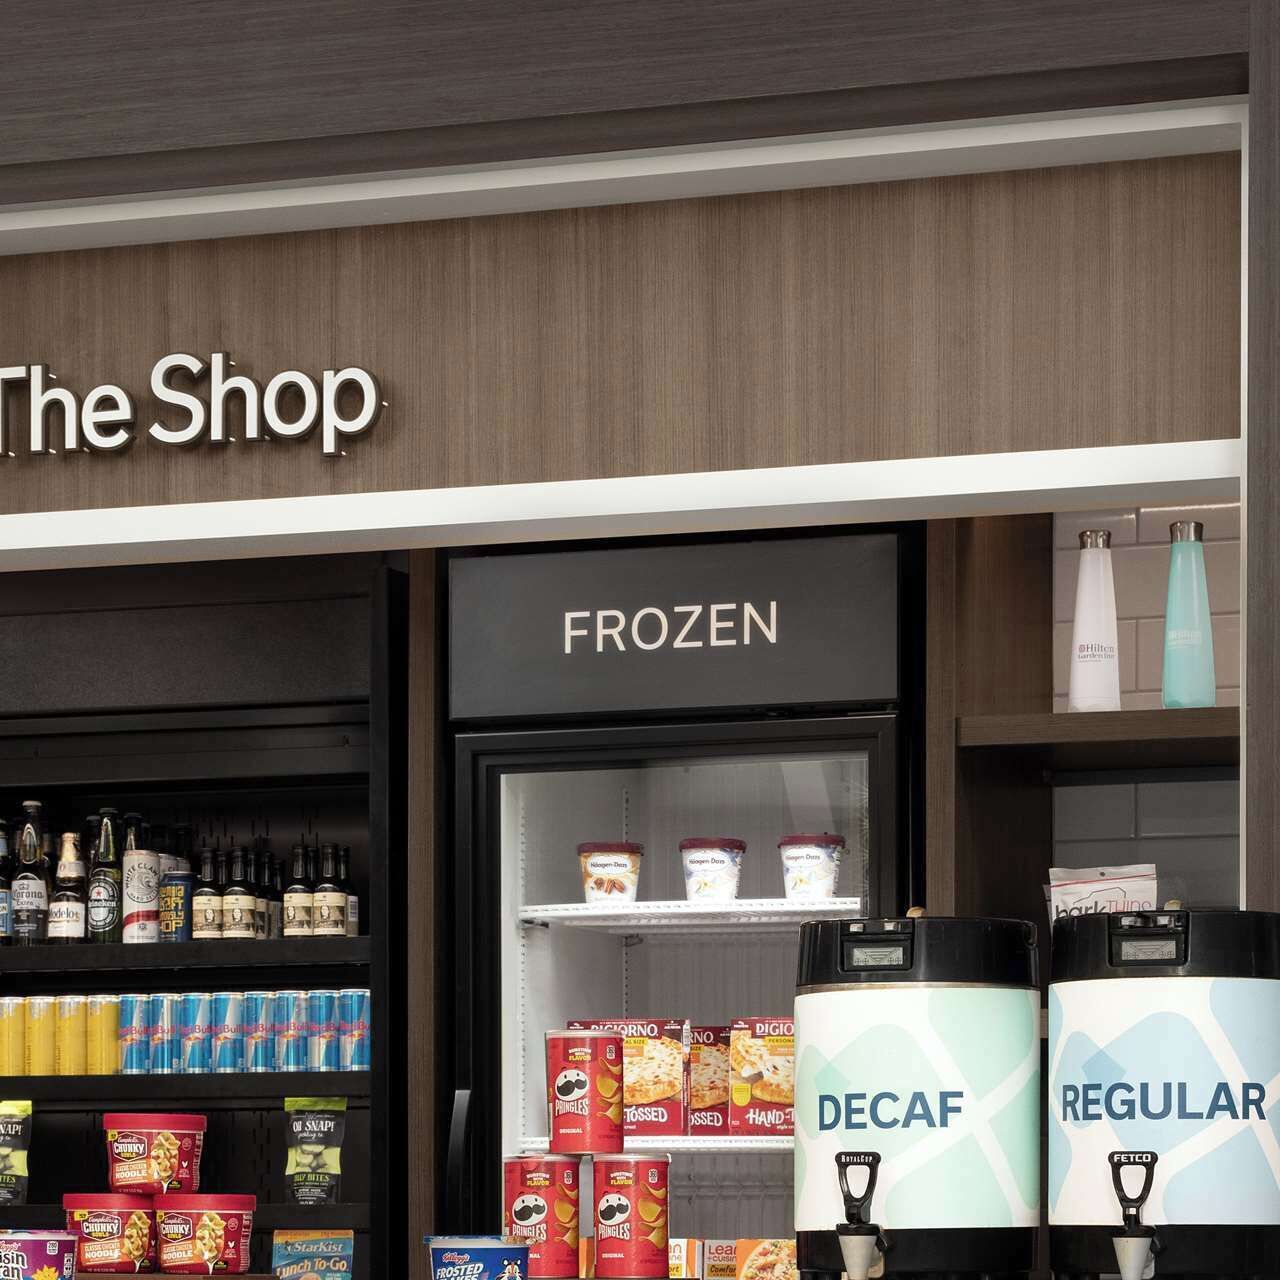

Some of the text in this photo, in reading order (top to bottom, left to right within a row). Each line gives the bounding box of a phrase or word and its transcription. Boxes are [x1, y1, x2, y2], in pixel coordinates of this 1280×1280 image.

[149, 352, 377, 456] Shop
[565, 601, 777, 654] FROZEN
[555, 1097, 589, 1117] PRINGLES
[1062, 1082, 1267, 1122] REGULAR
[818, 1091, 964, 1132] DECAF
[305, 1121, 335, 1132] SNAP!
[113, 1142, 145, 1154] CHUNKY
[1113, 1153, 1152, 1163] FETCO
[115, 1170, 147, 1179] NOODLE
[83, 1222, 118, 1235] CHUNKY
[160, 1223, 189, 1235] CHUNKY
[512, 1222, 547, 1242] PRINGLES
[598, 1222, 631, 1241] PRINGLES
[85, 1249, 122, 1258] NOODLE
[293, 1242, 343, 1254] StarKist
[162, 1250, 193, 1260] NOODLE
[442, 1252, 469, 1263] Kellogg's
[276, 1258, 348, 1278] Lunch To-Go
[436, 1263, 484, 1279] FROSTED
